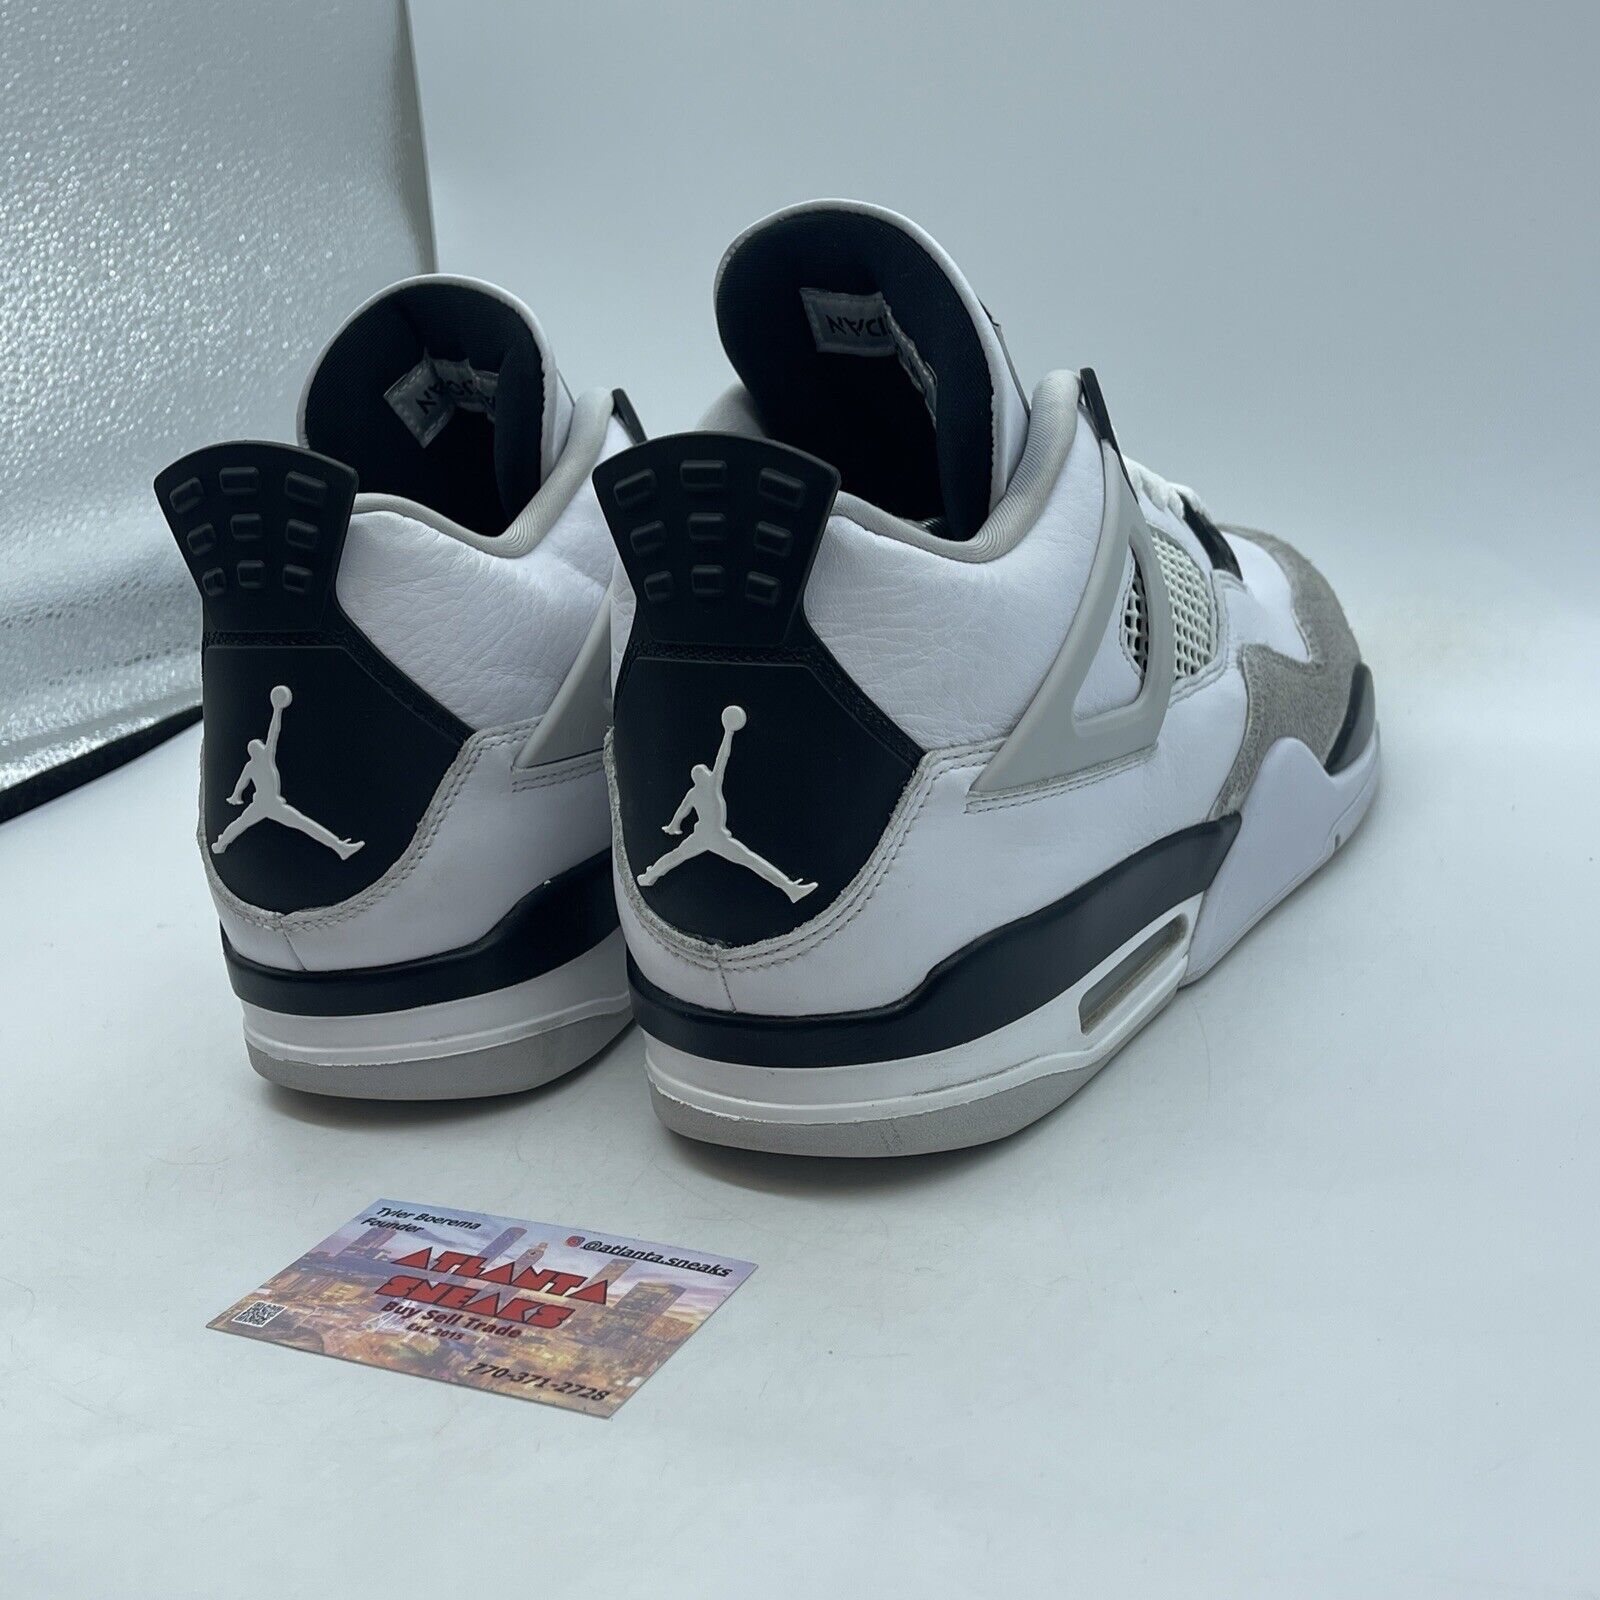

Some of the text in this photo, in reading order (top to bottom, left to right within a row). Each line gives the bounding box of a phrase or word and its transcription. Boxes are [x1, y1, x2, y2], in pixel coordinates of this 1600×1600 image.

[360, 1217, 425, 1233] Founder
[376, 1207, 482, 1230] Tyler Boerema
[390, 1246, 608, 1305] ATLANTA
[580, 1240, 733, 1278] @atlanta.sneaks
[374, 1275, 576, 1329] SNEAKS
[380, 1301, 522, 1338] Buy Sell Trade
[406, 1322, 465, 1341] Est. 2015
[467, 1362, 611, 1401] 770-371-2728
